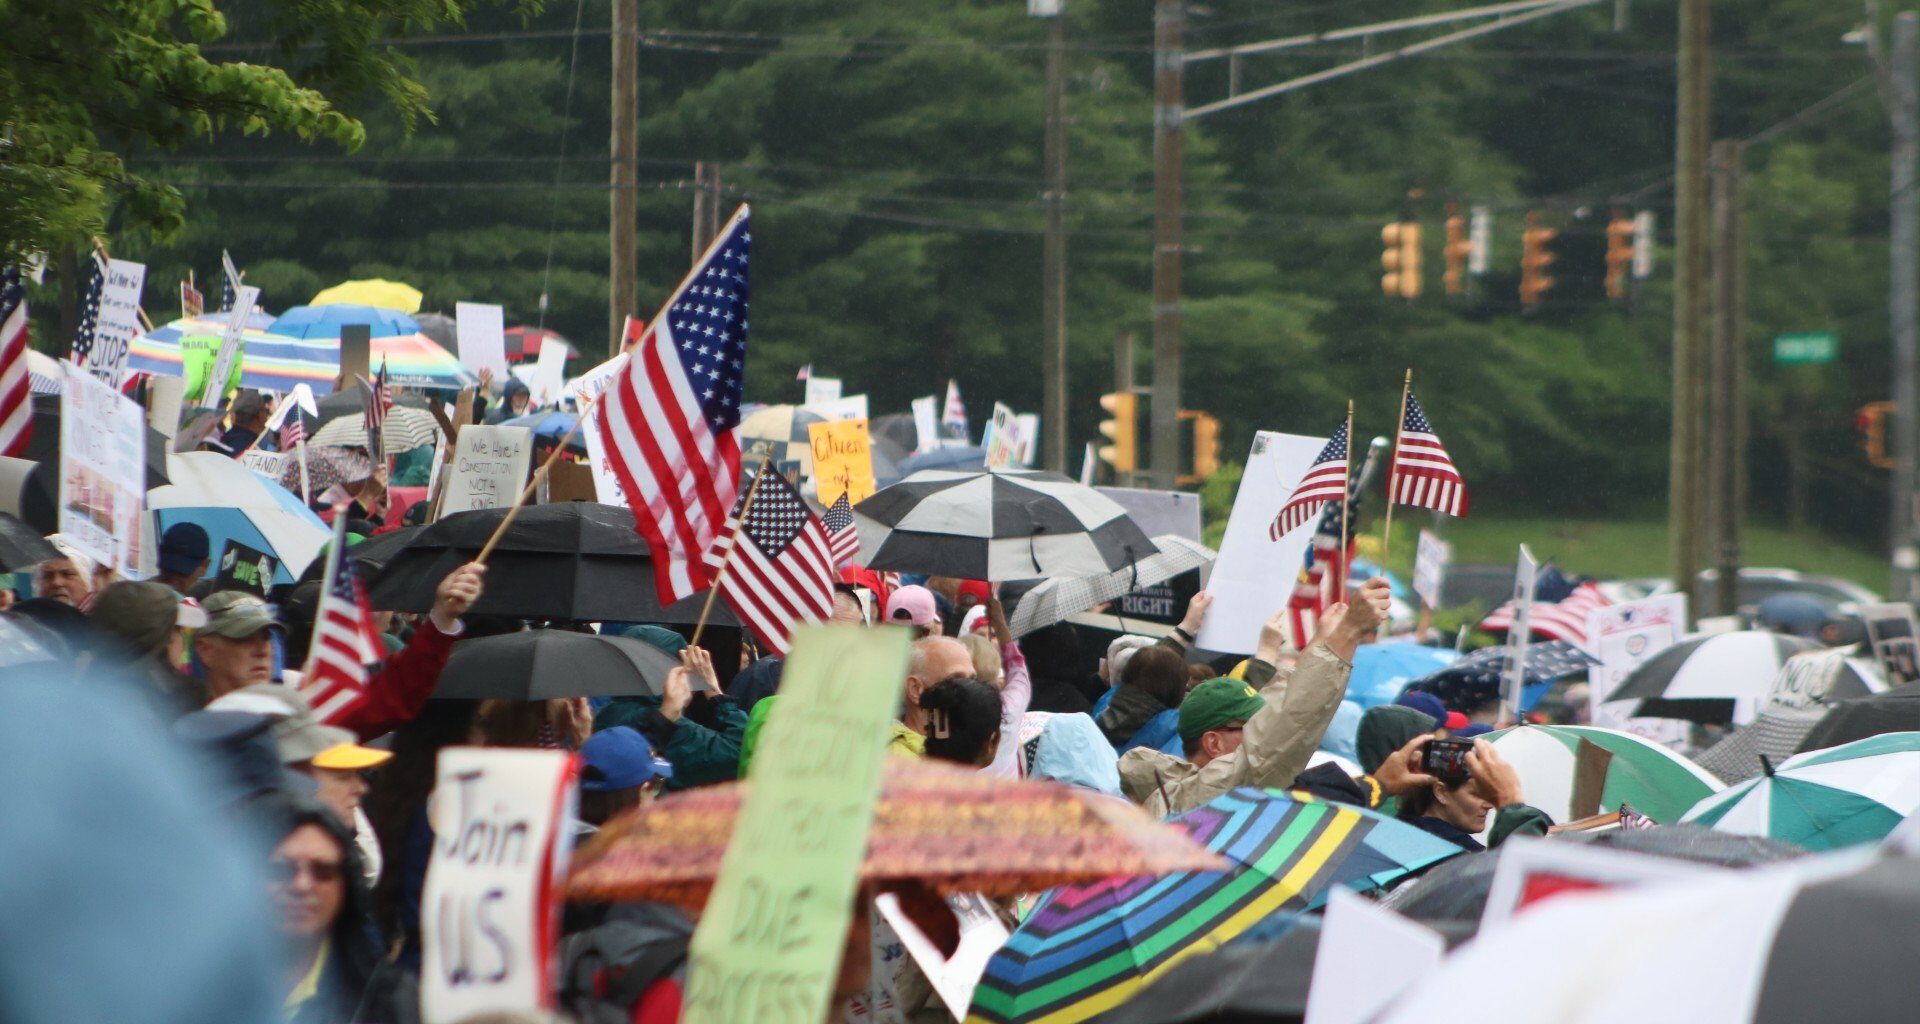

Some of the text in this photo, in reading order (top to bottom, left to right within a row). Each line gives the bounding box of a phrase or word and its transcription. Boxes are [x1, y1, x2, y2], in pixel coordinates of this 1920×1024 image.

[91, 333, 128, 370] STOP
[1122, 596, 1174, 616] RIGHT
[440, 768, 529, 866] Join
